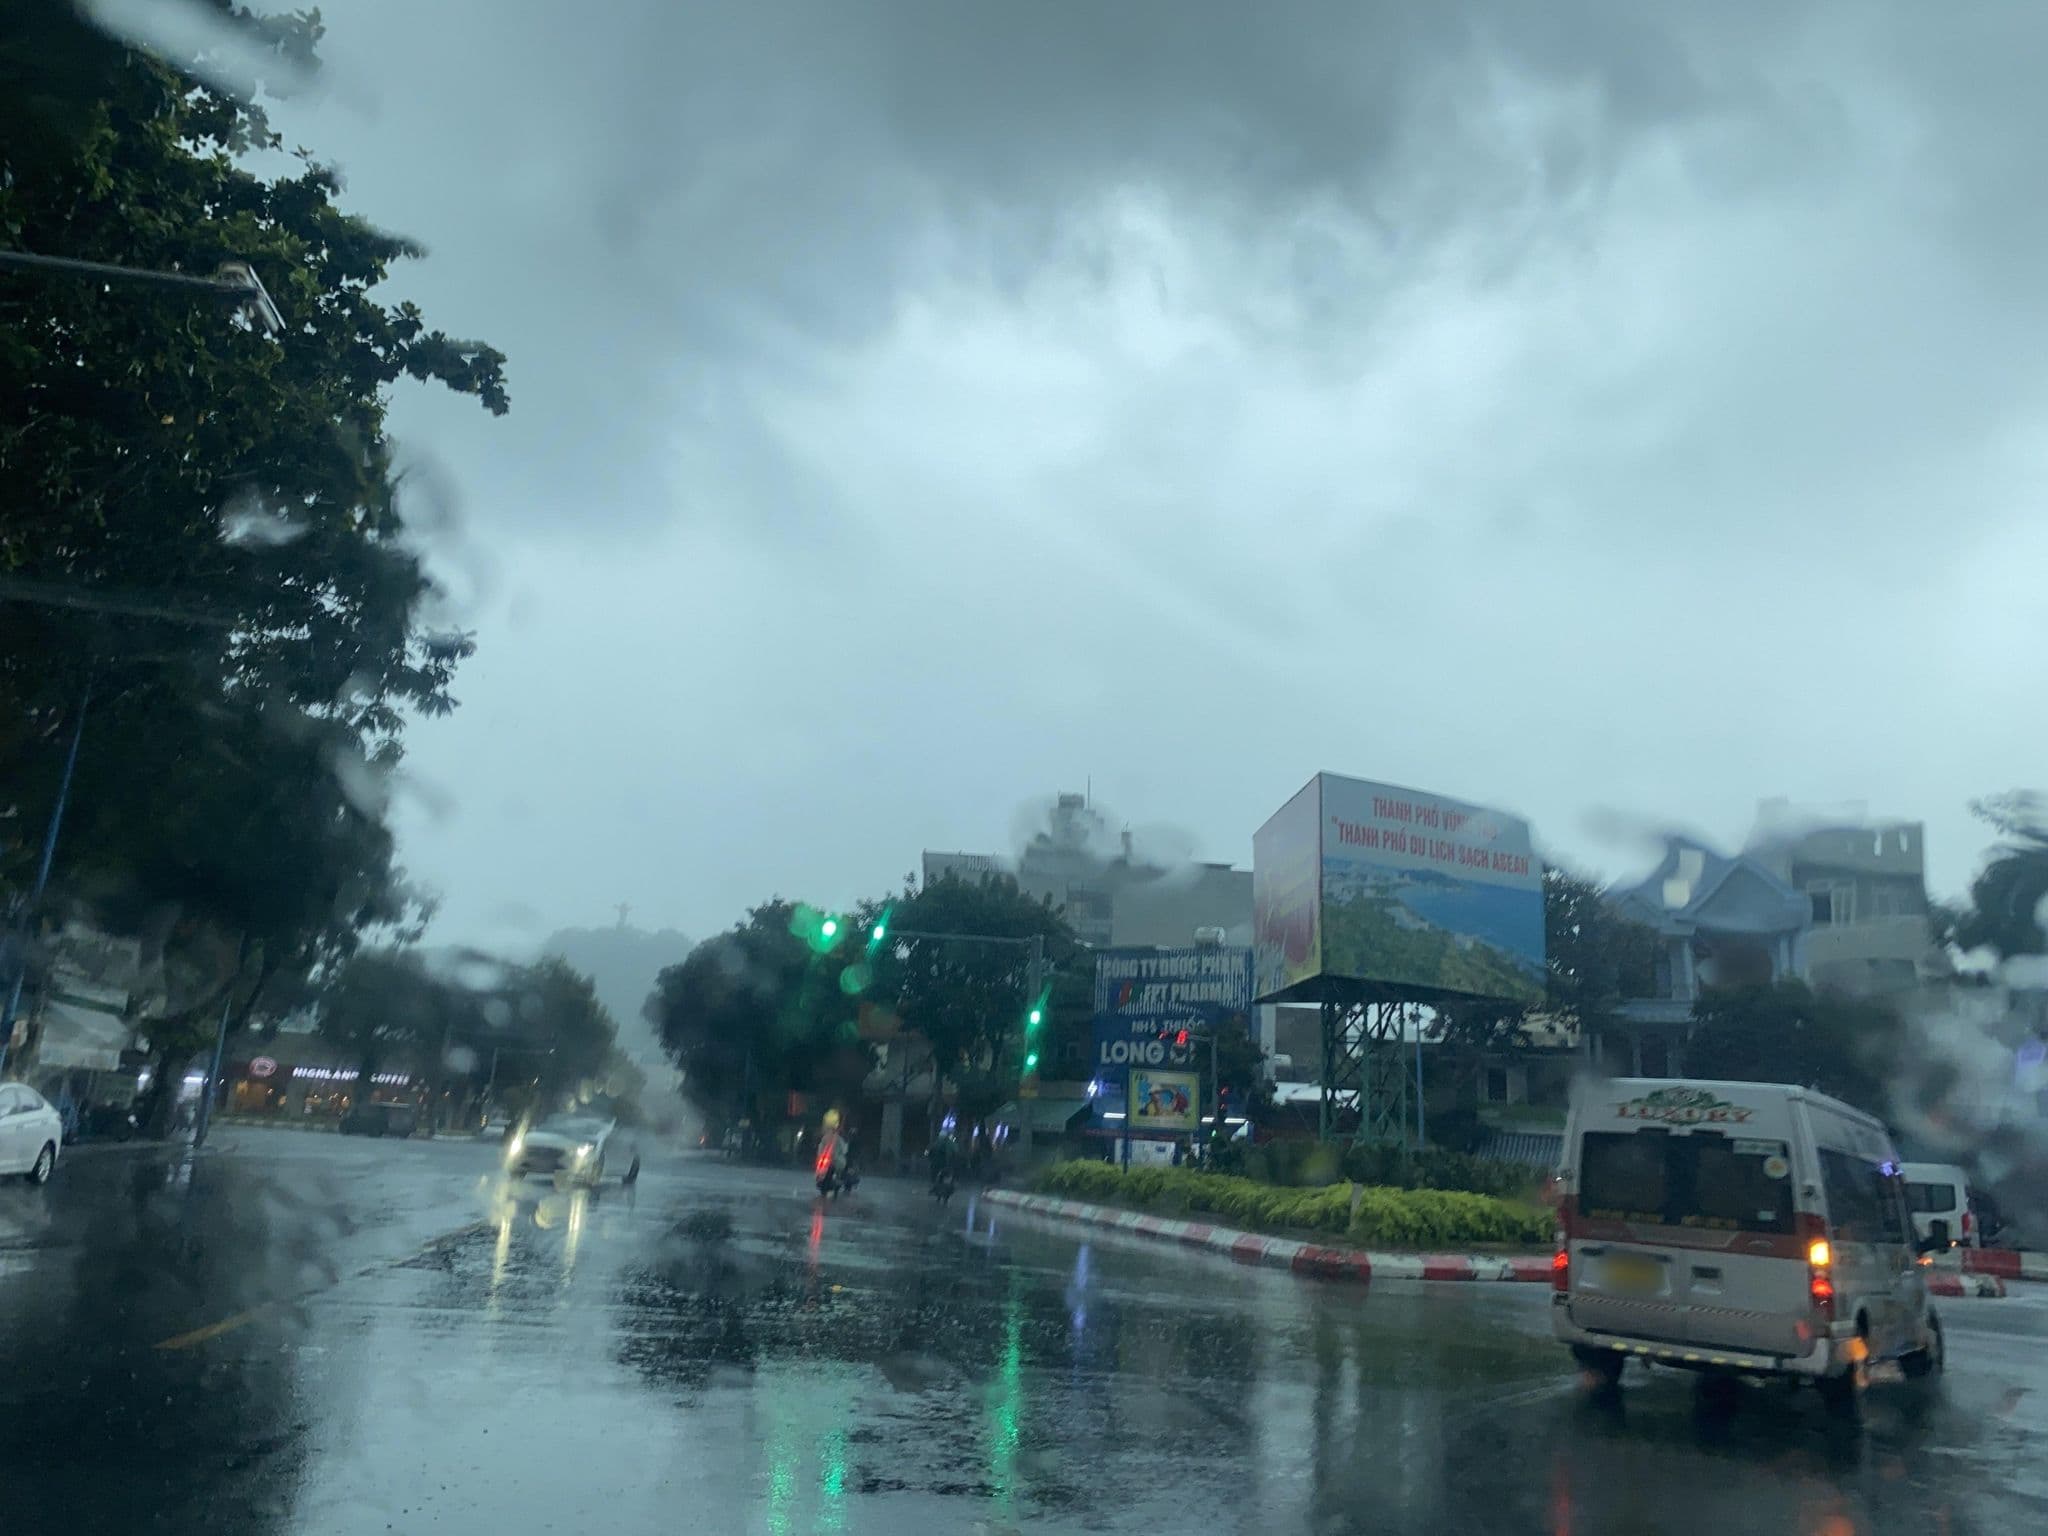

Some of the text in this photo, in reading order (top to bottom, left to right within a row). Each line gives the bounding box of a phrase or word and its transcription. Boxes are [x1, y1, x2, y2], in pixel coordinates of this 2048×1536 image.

[1382, 826, 1406, 853] PHỐ
[1410, 834, 1426, 857] DU
[1140, 957, 1158, 978] TY
[1100, 1040, 1165, 1065] LONG
[292, 1066, 360, 1081] HIGHLAND
